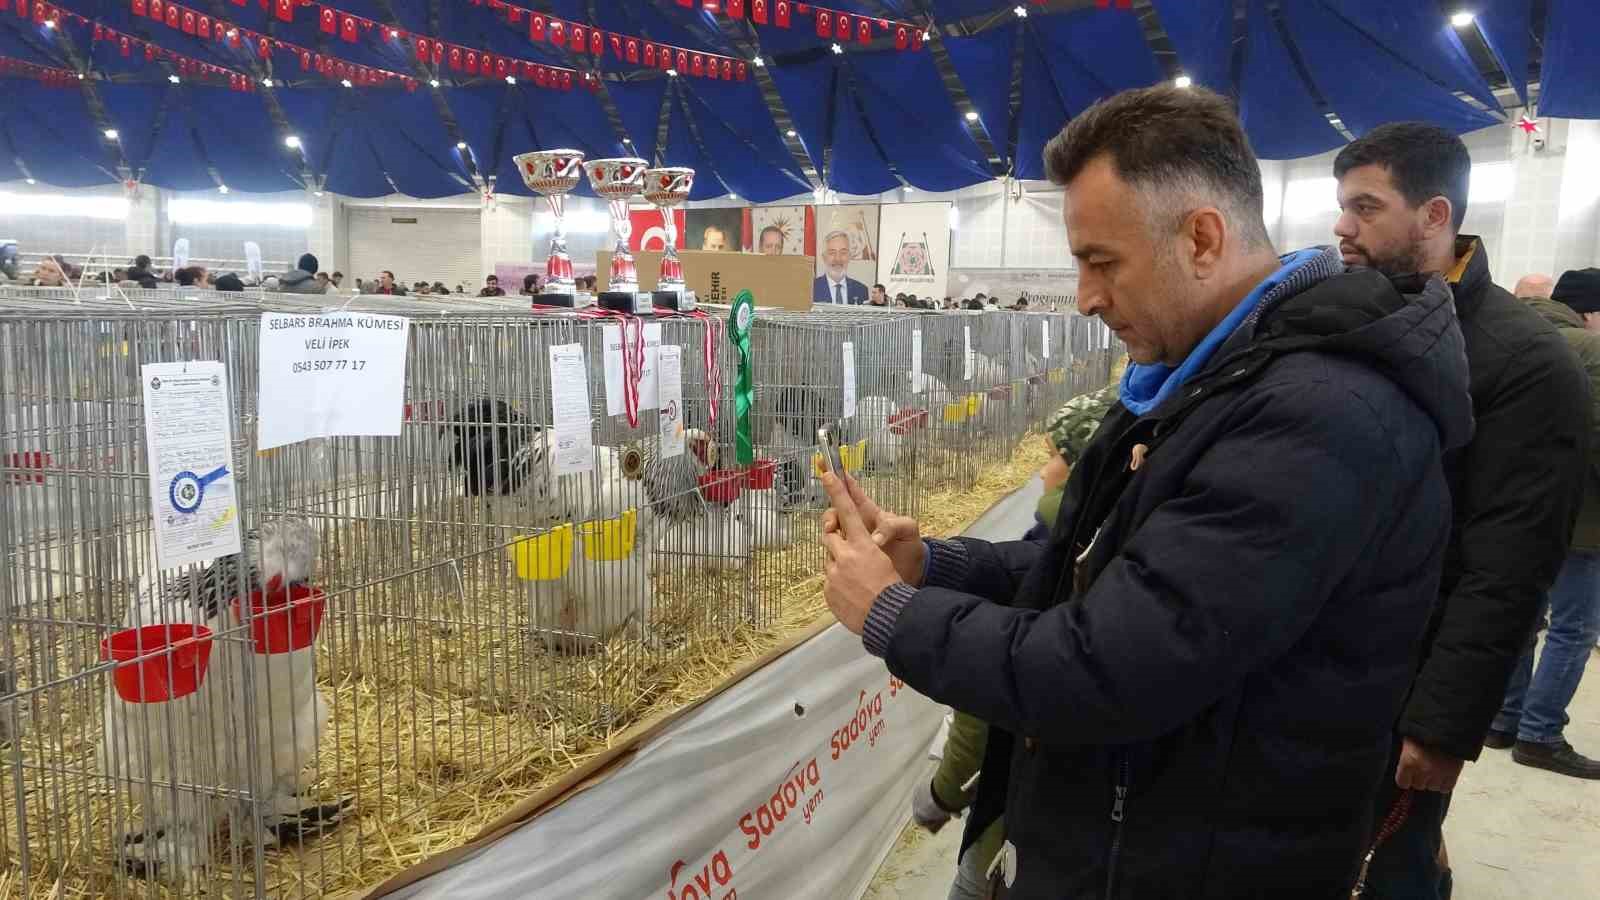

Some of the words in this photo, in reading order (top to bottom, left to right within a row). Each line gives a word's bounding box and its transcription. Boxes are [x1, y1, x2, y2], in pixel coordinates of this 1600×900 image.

[269, 317, 306, 330] SELBARS
[308, 317, 354, 329] BRAHMA
[357, 316, 404, 330] KÜMESİ
[304, 337, 326, 350] VELİ
[328, 337, 350, 350] İPEK
[292, 361, 312, 373] 0543
[314, 360, 333, 371] 507
[335, 360, 348, 370] 77
[352, 360, 367, 370] 17
[869, 719, 886, 747] yem
[803, 789, 824, 824] yem
